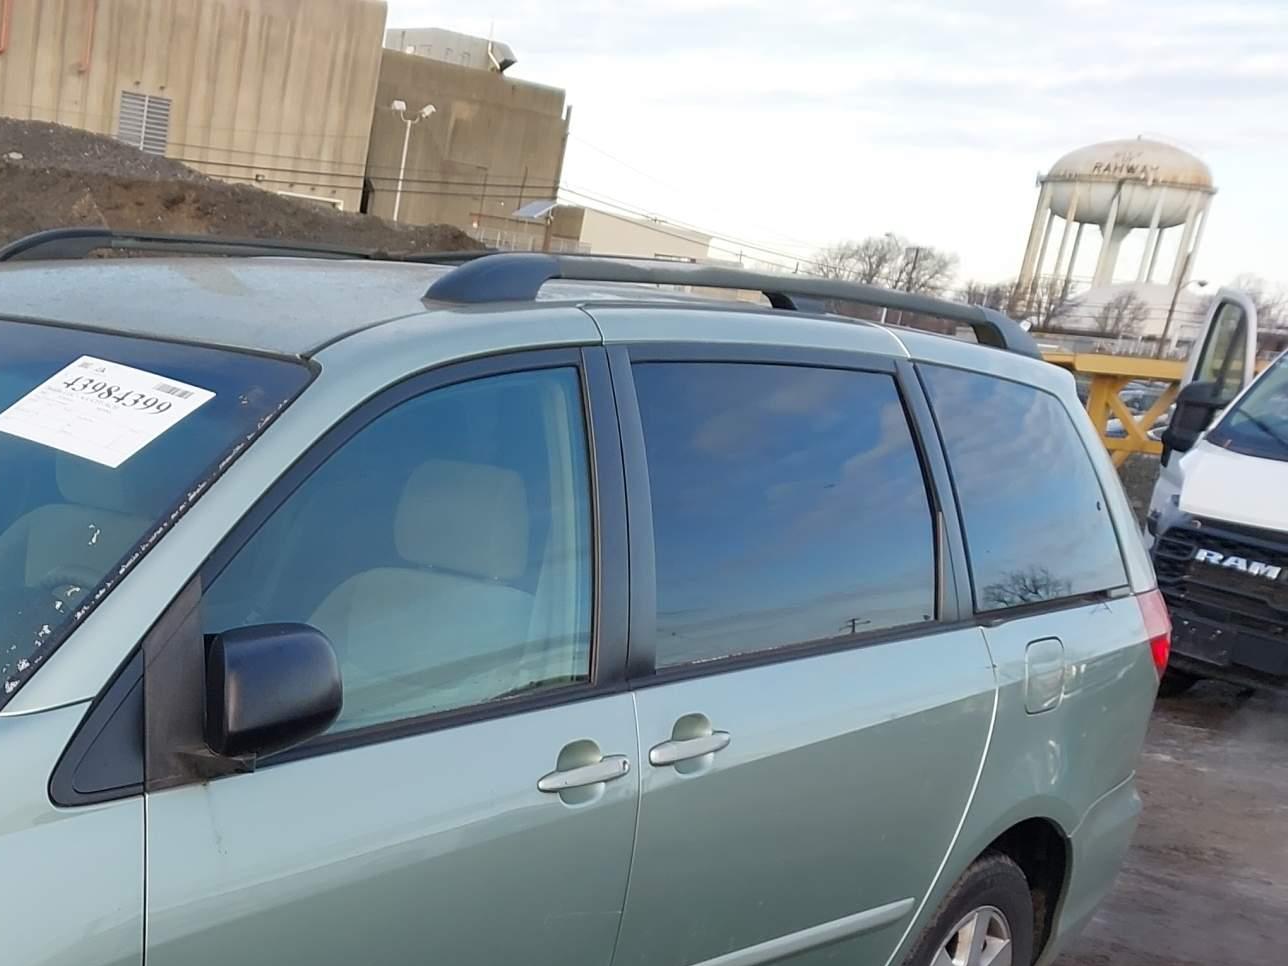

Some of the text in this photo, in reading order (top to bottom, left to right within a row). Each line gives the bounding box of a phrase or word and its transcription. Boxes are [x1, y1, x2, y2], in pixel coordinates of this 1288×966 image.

[1092, 162, 1161, 177] RAHWAY
[62, 375, 173, 415] 43984399
[1194, 548, 1282, 580] RAM
